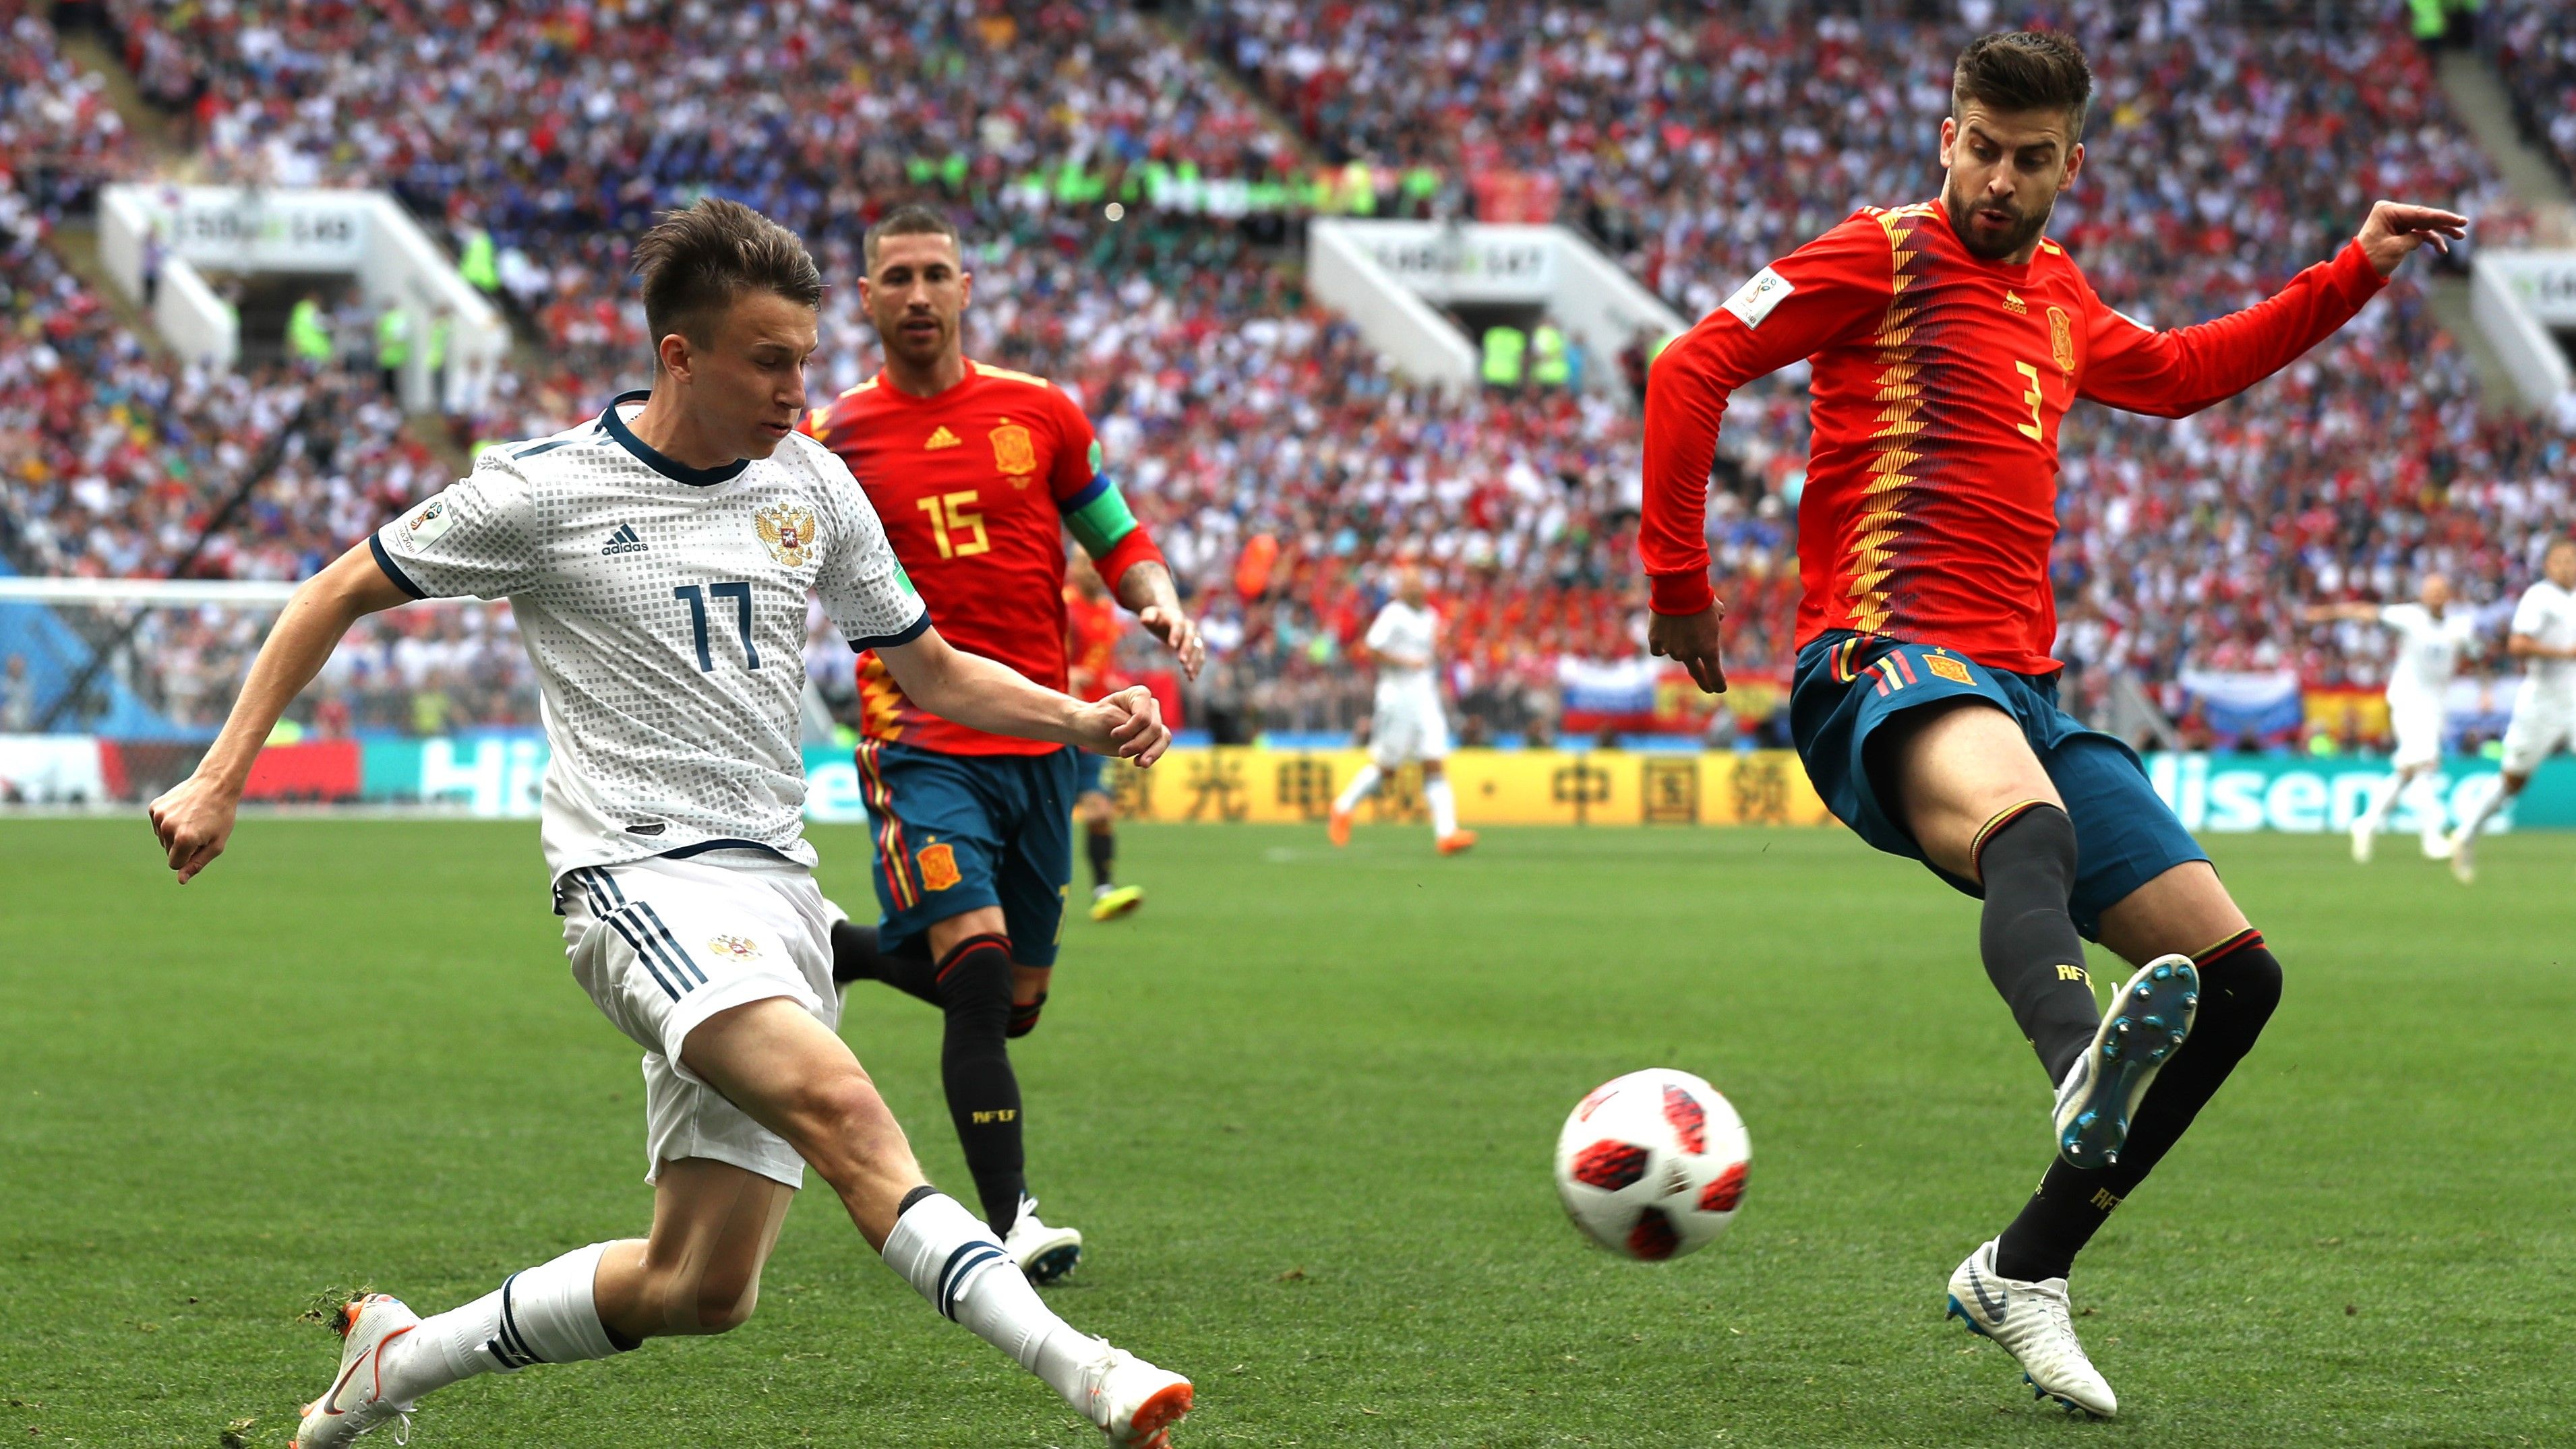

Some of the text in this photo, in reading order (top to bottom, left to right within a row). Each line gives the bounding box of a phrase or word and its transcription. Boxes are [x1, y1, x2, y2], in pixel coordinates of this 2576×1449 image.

[2002, 301, 2027, 315] adidas
[2014, 360, 2043, 443] 3
[601, 542, 649, 556] adidas
[916, 489, 990, 559] 15
[674, 582, 760, 673] 17
